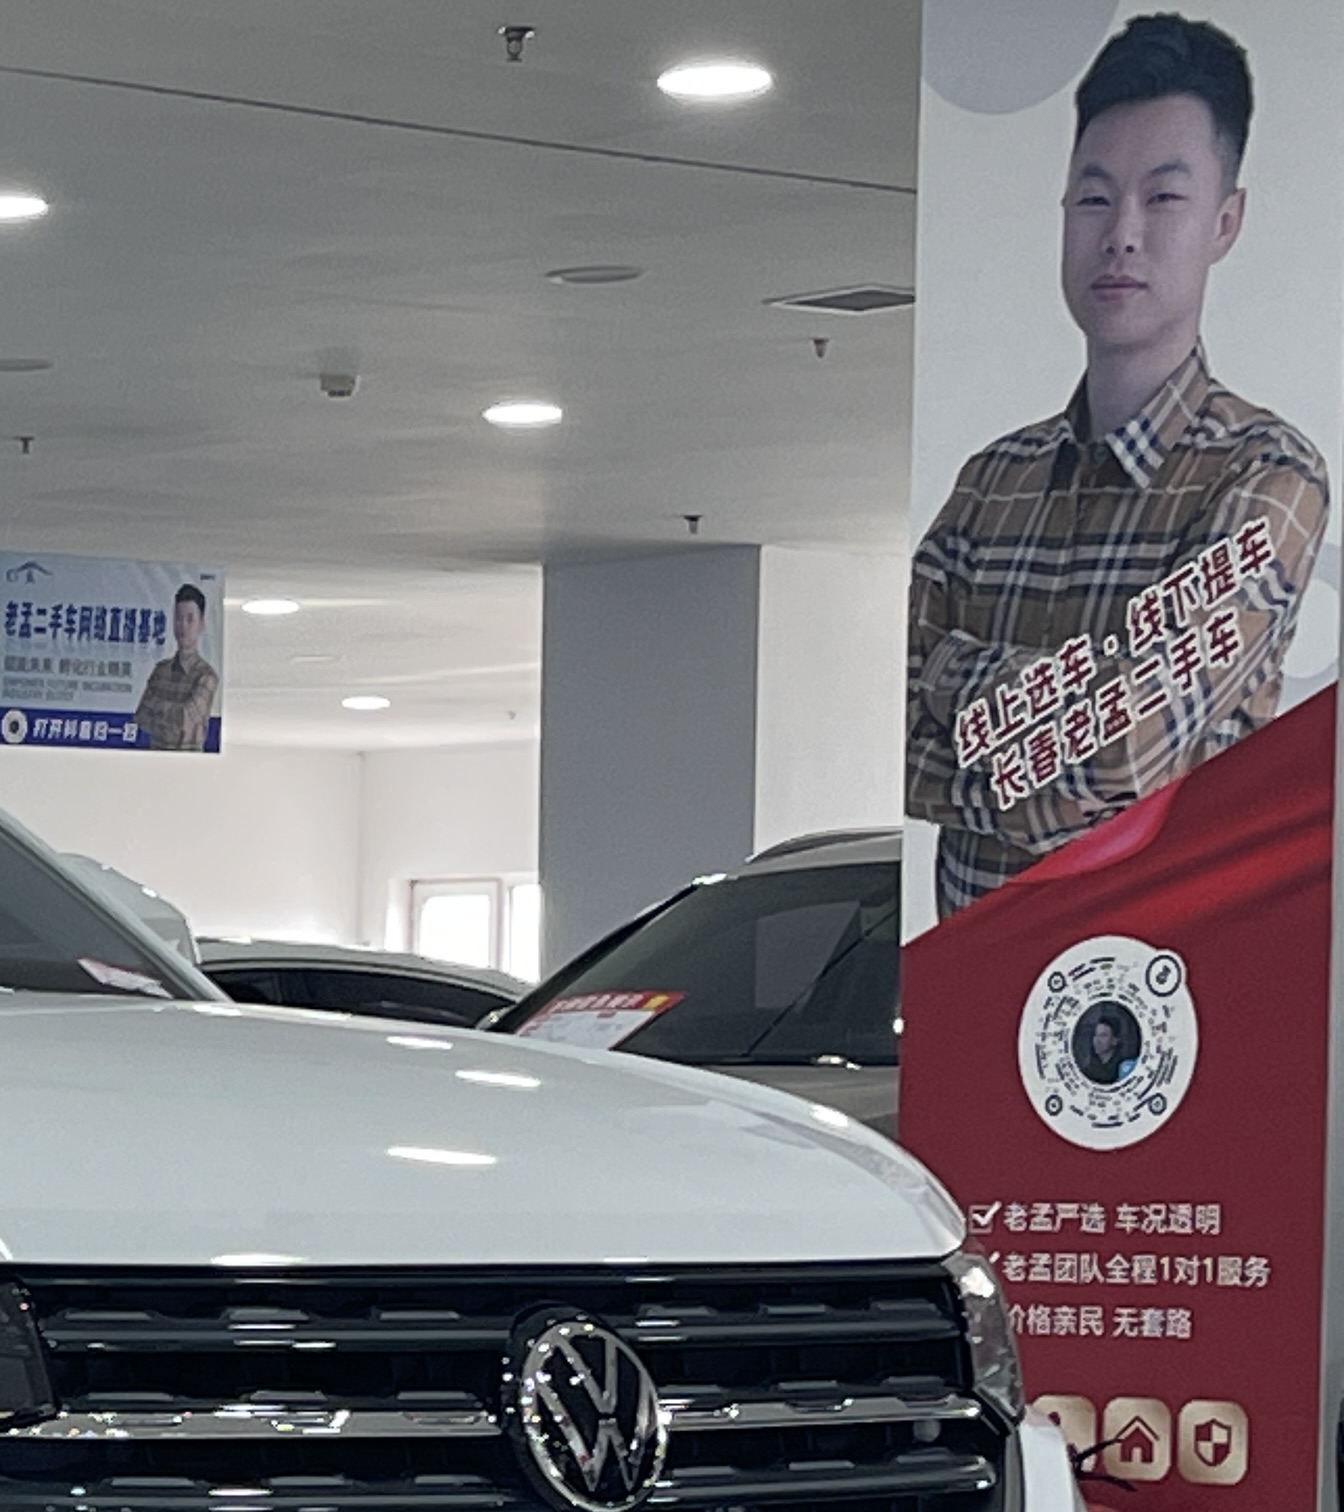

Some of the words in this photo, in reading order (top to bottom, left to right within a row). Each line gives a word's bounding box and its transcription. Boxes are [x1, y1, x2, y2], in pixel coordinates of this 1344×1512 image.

[4, 601, 167, 645] 老孟二手车网络直播基地
[991, 609, 1244, 811] 长春老孟二手车
[1003, 1203, 1106, 1233] 老孟严选
[1115, 1203, 1221, 1235] 车况透明
[1002, 1253, 1271, 1287] 老孟团队全程1对1服务
[1008, 1304, 1104, 1336] 价格亲民
[1112, 1307, 1192, 1339] 无套路
